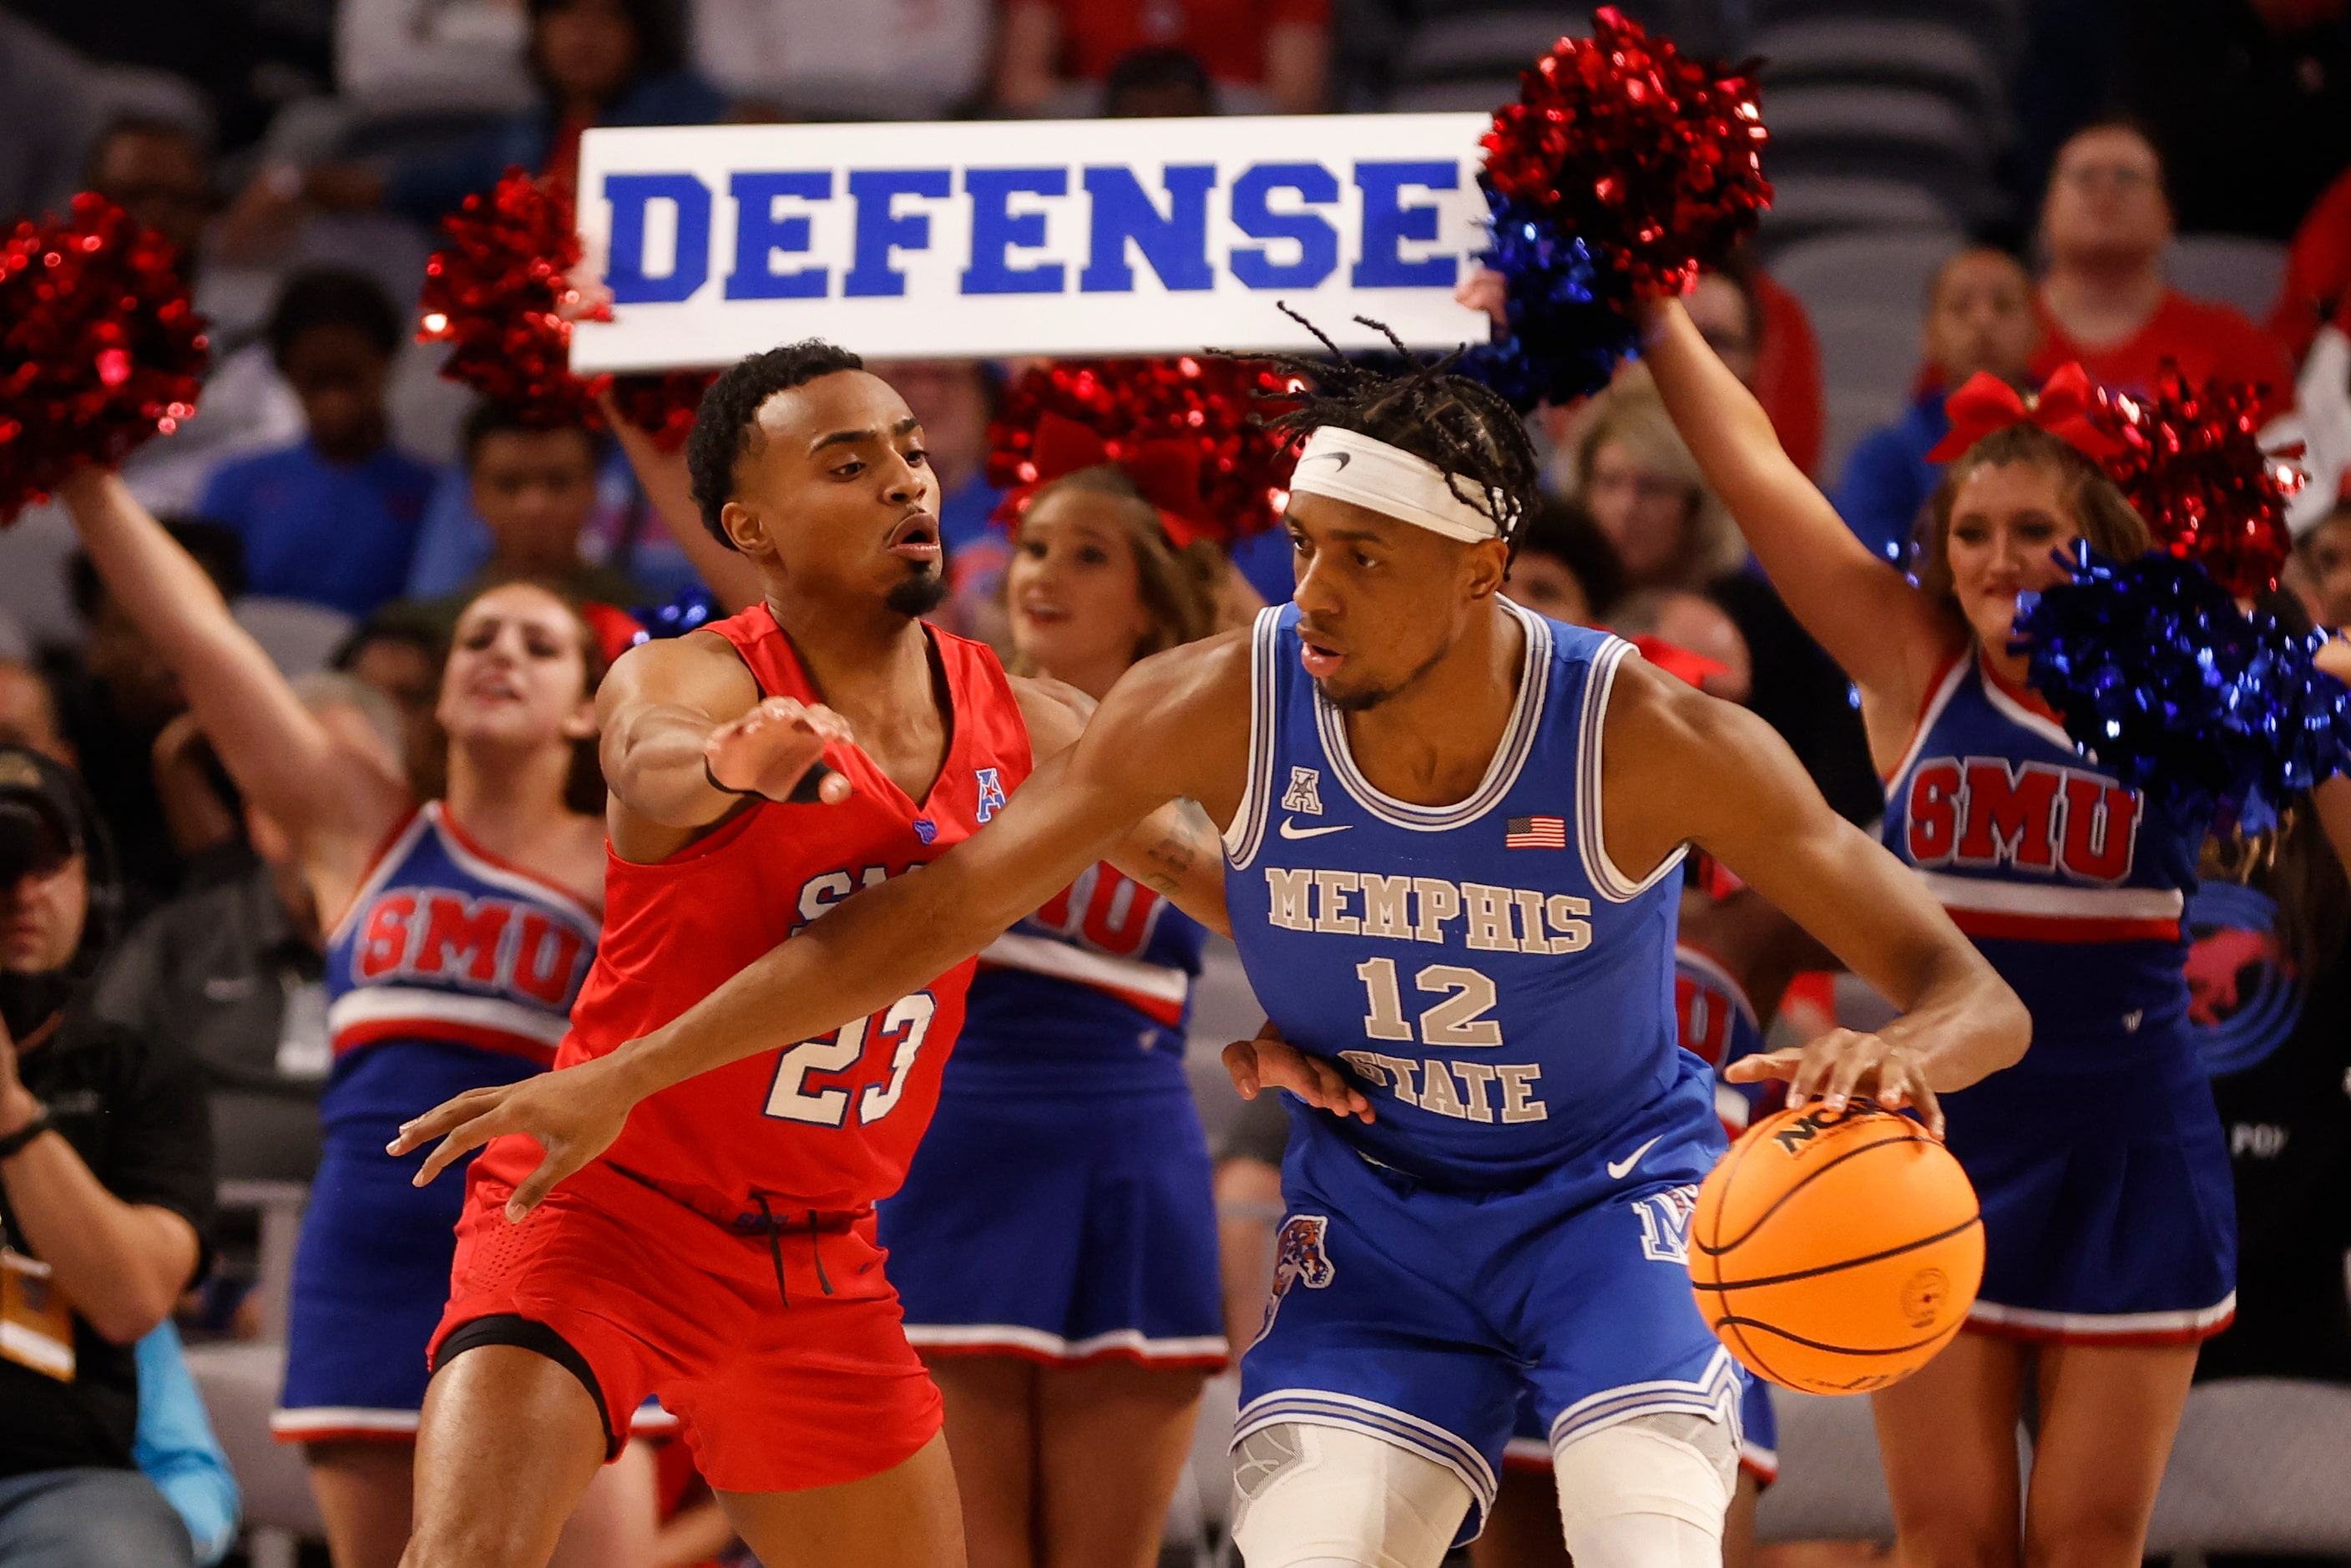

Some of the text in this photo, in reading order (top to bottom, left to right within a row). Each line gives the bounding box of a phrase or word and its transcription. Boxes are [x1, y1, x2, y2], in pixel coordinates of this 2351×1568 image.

[603, 159, 1459, 303] DEFENSE
[1905, 756, 2144, 887] SMU
[352, 887, 584, 1006] SMU
[1265, 867, 1593, 954] MEMPHIS
[762, 989, 938, 1128] 23
[1356, 957, 1504, 1047] 12
[1337, 1050, 1549, 1124] STATE
